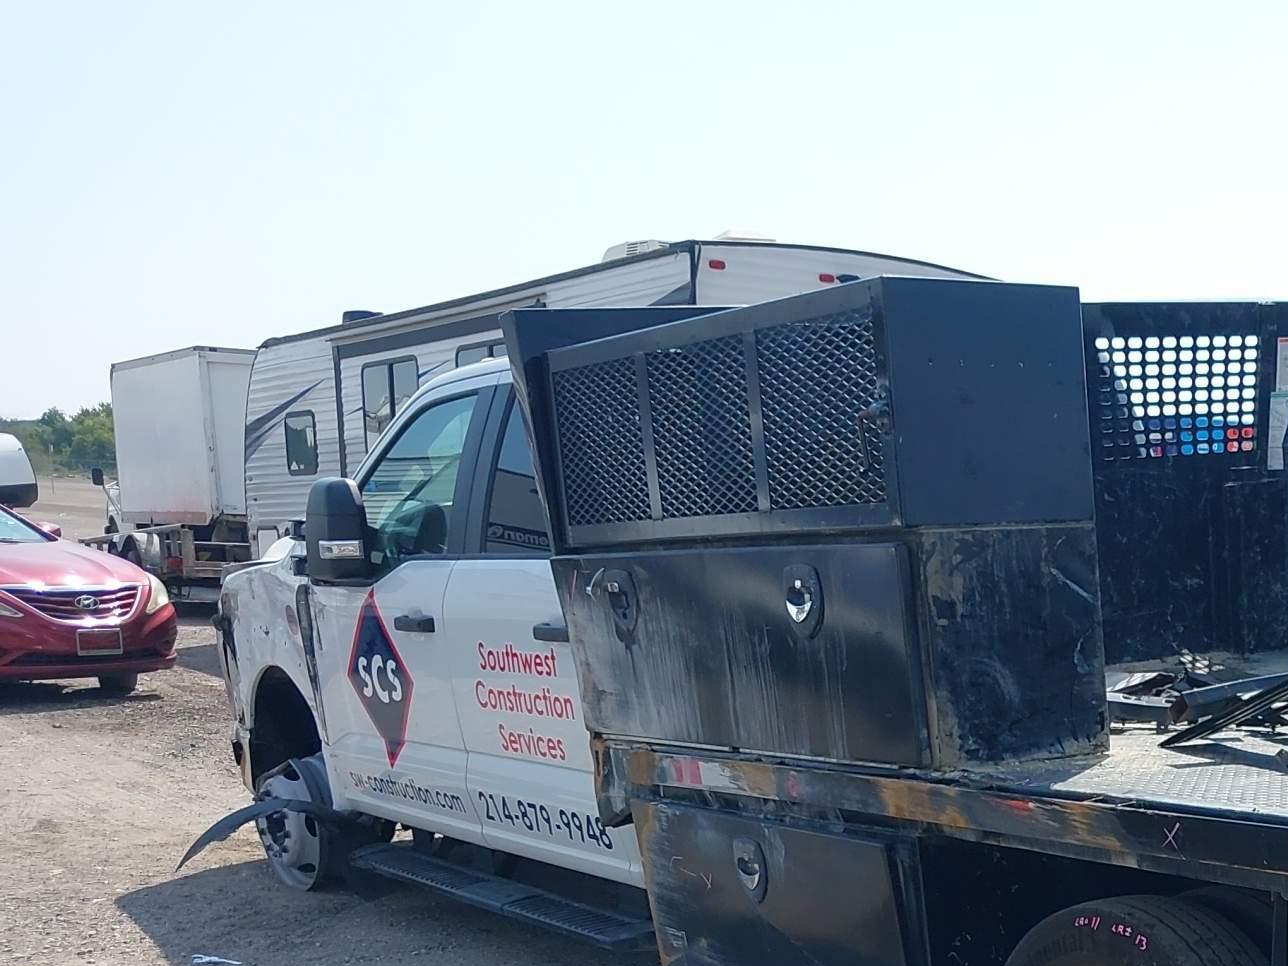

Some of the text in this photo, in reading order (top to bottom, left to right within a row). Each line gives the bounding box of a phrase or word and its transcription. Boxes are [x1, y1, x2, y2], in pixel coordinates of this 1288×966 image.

[358, 653, 403, 704] SCS
[478, 642, 558, 678] Southwest
[475, 680, 575, 721] Construction
[498, 723, 566, 761] Services
[349, 771, 467, 814] sw-construction.com
[478, 791, 614, 850] 214-879-9948
